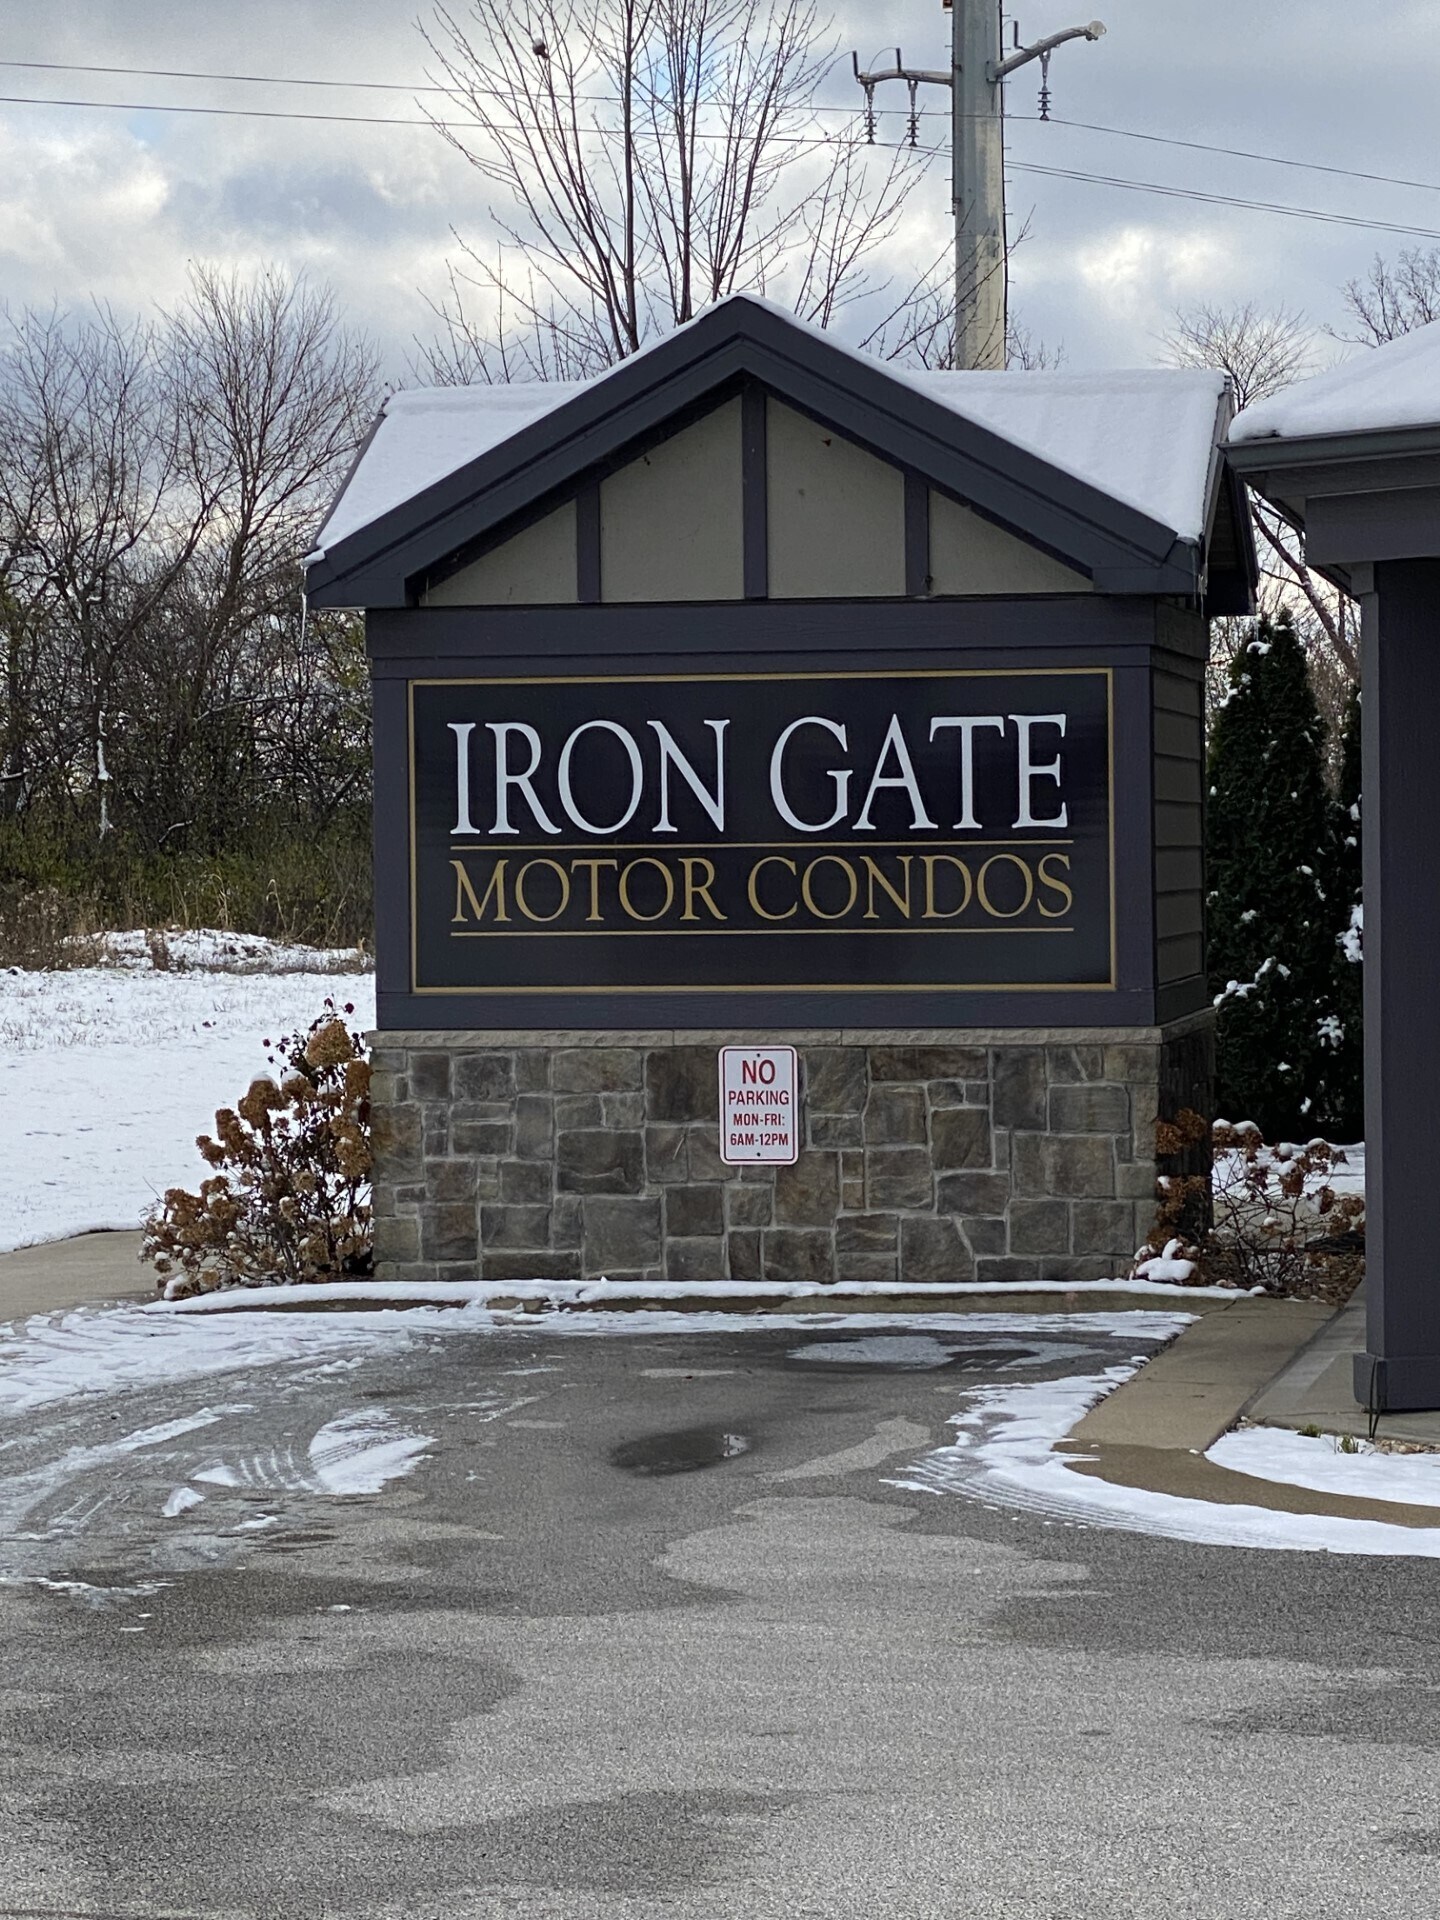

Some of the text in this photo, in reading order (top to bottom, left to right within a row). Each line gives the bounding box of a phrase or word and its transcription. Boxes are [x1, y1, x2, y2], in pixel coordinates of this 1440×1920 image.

[447, 713, 1069, 835] IRON GATE
[449, 853, 1074, 922] MOTOR CONDOS
[742, 1059, 775, 1084] NO
[728, 1090, 789, 1105] PARKING
[730, 1132, 788, 1145] 6AM-12PM
